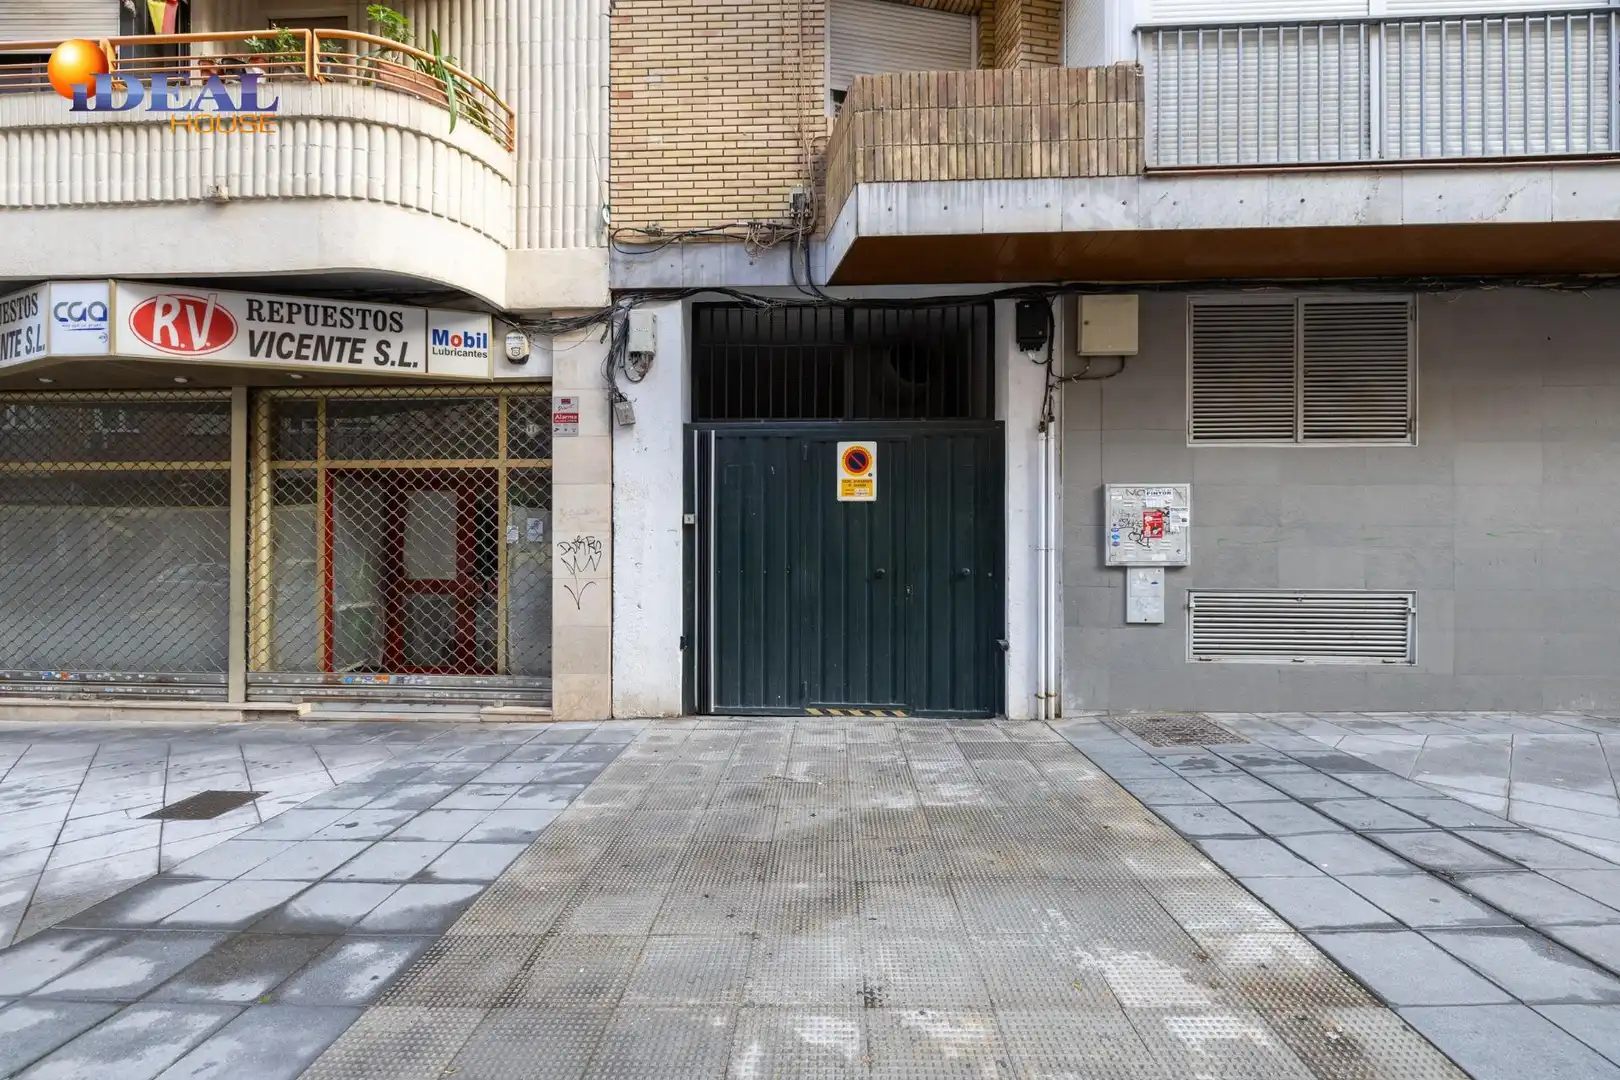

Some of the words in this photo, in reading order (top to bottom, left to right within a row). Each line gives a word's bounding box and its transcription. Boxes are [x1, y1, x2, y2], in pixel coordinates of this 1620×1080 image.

[246, 298, 404, 333] REPUESTOS
[25, 324, 45, 355] S.L.
[248, 330, 366, 365] VICENTE
[373, 340, 419, 369] S.L.
[432, 329, 488, 349] Mobil
[432, 347, 488, 359] Lubricantes
